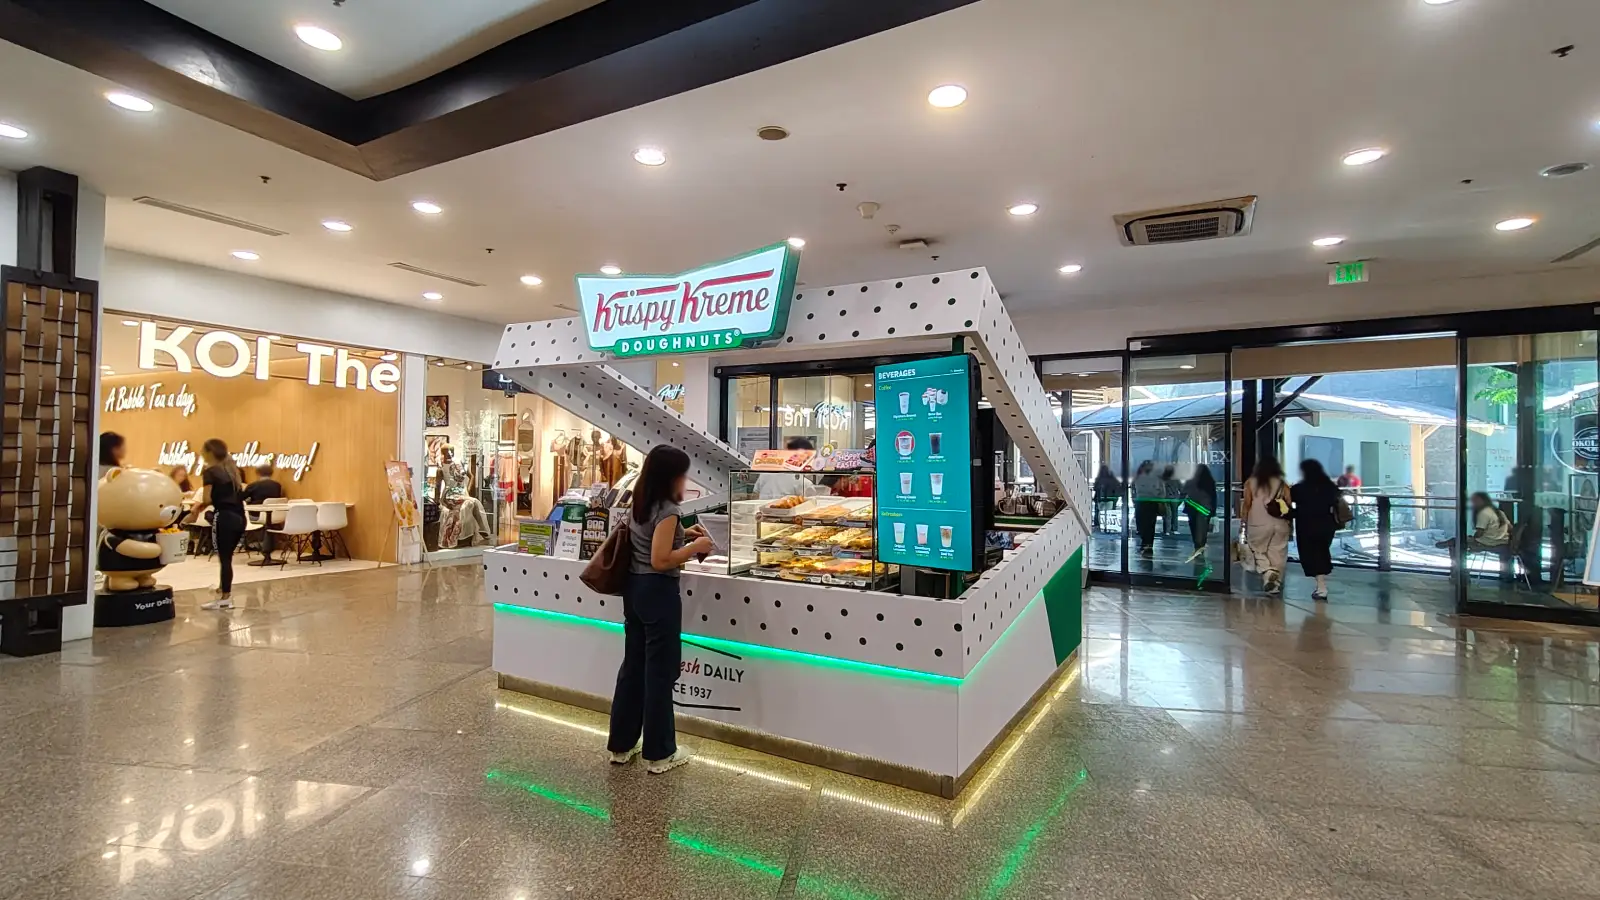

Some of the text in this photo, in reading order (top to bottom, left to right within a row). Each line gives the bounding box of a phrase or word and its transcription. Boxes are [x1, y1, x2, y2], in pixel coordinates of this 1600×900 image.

[1335, 262, 1363, 283] EXIT
[593, 268, 774, 332] Krispy Kreme
[138, 320, 401, 393] KOI Thé
[878, 368, 916, 380] BEVERAGES
[104, 387, 116, 412] A
[116, 385, 146, 412] Bubble
[149, 382, 167, 410] Tea
[167, 393, 176, 408] a
[158, 440, 196, 476] bubbling
[229, 440, 274, 468] roblems
[276, 441, 320, 482] away!
[836, 459, 862, 469] EASTER
[134, 601, 156, 610] Your
[680, 658, 744, 683] esh DAILY
[689, 685, 713, 699] 1937
